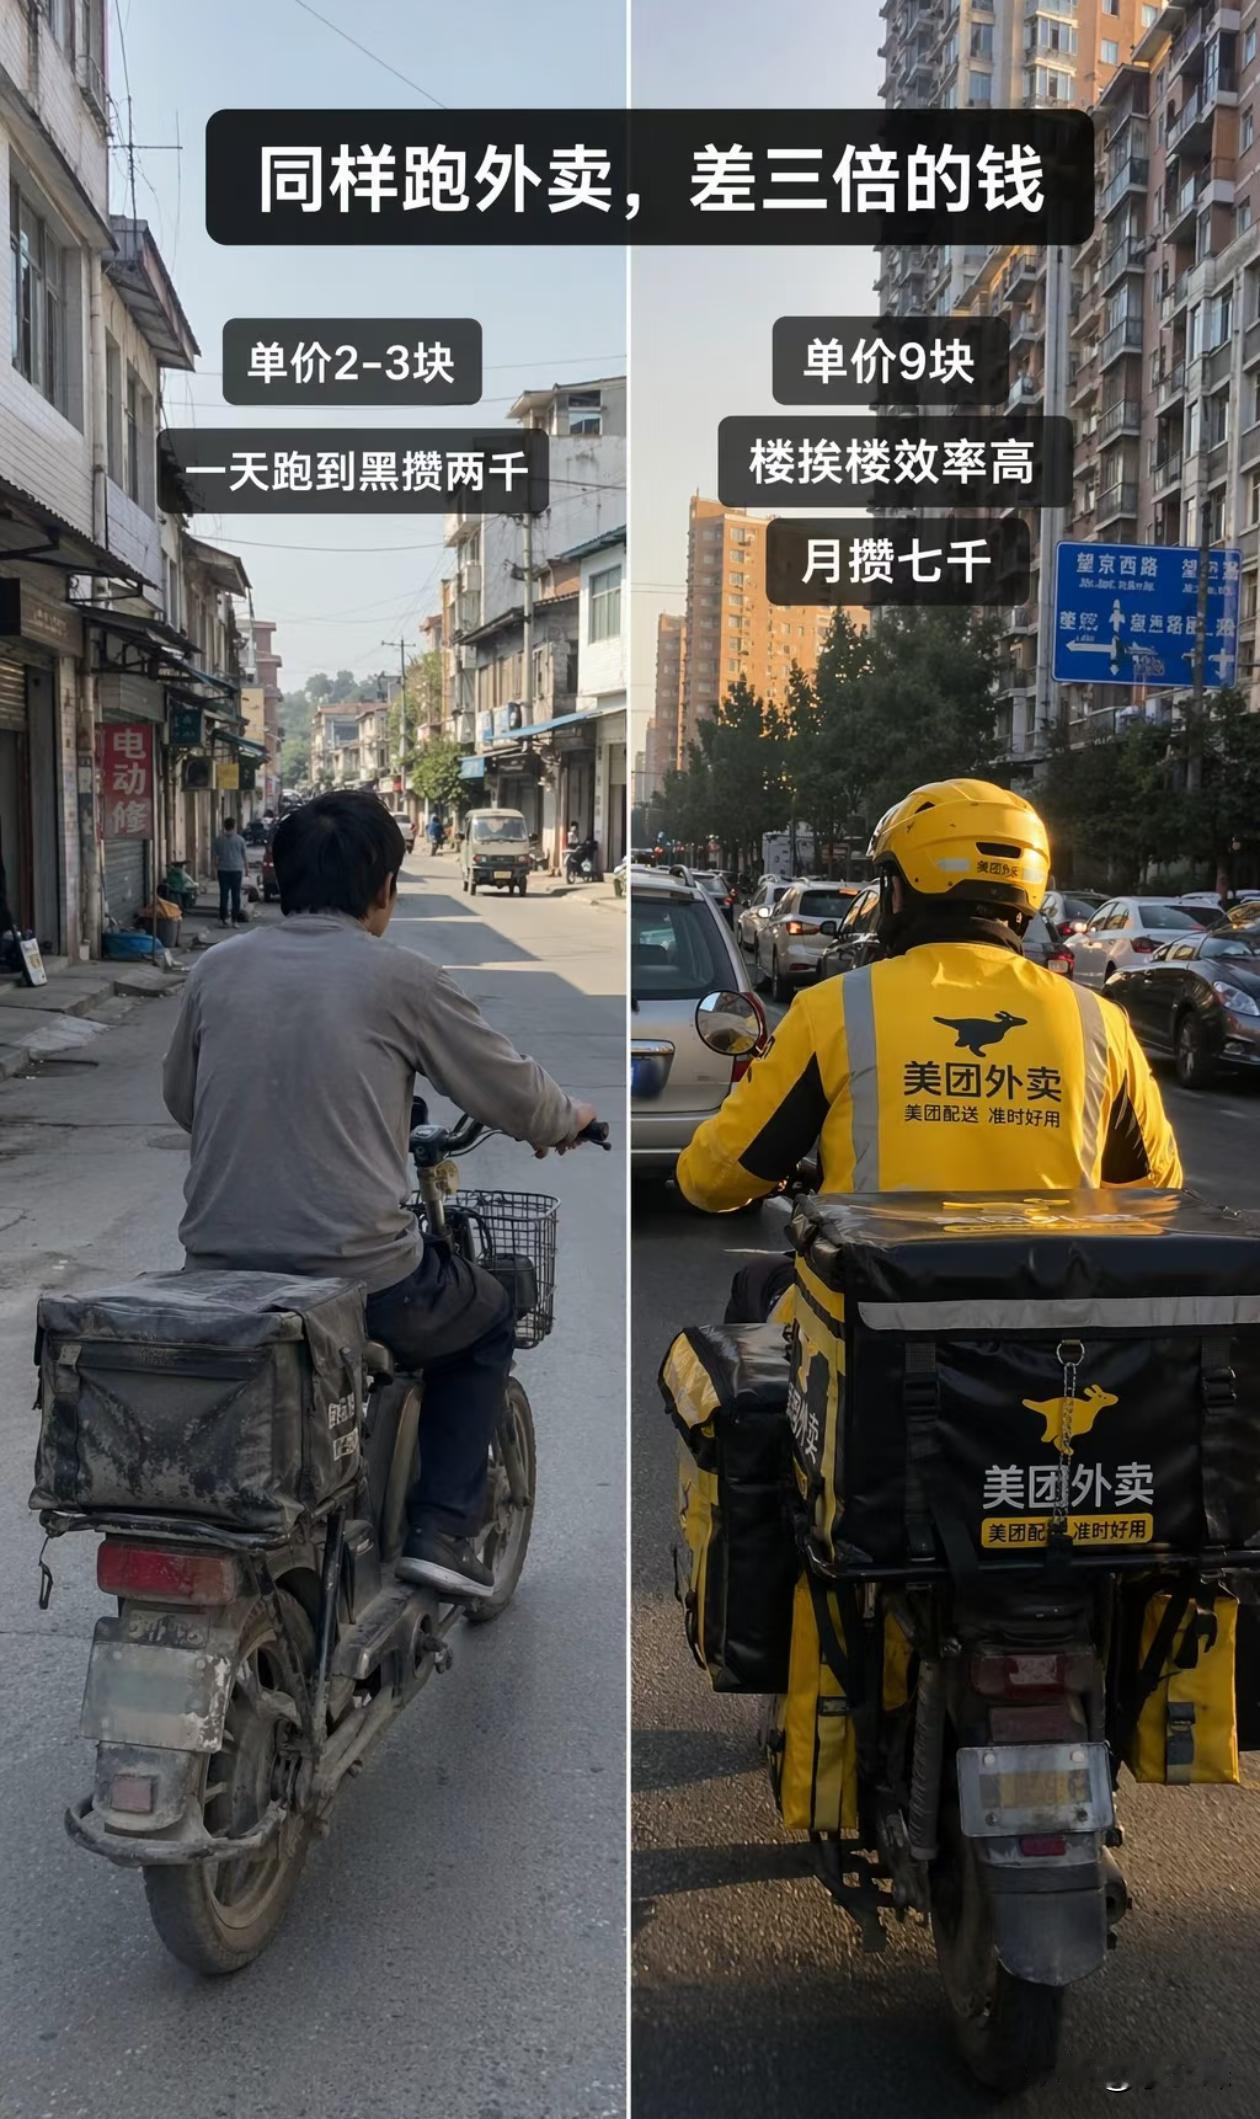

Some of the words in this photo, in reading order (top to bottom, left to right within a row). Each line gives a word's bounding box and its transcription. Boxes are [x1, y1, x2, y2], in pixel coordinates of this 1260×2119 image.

[1076, 552, 1158, 577] 望京西路
[903, 1060, 1062, 1102] 美团外卖
[904, 1104, 979, 1124] 美团配送
[988, 1106, 1060, 1128] 准时好用
[982, 1461, 1154, 1510] 美团外卖
[988, 1522, 1064, 1543] 美团配
[1073, 1519, 1146, 1541] 准时好用
